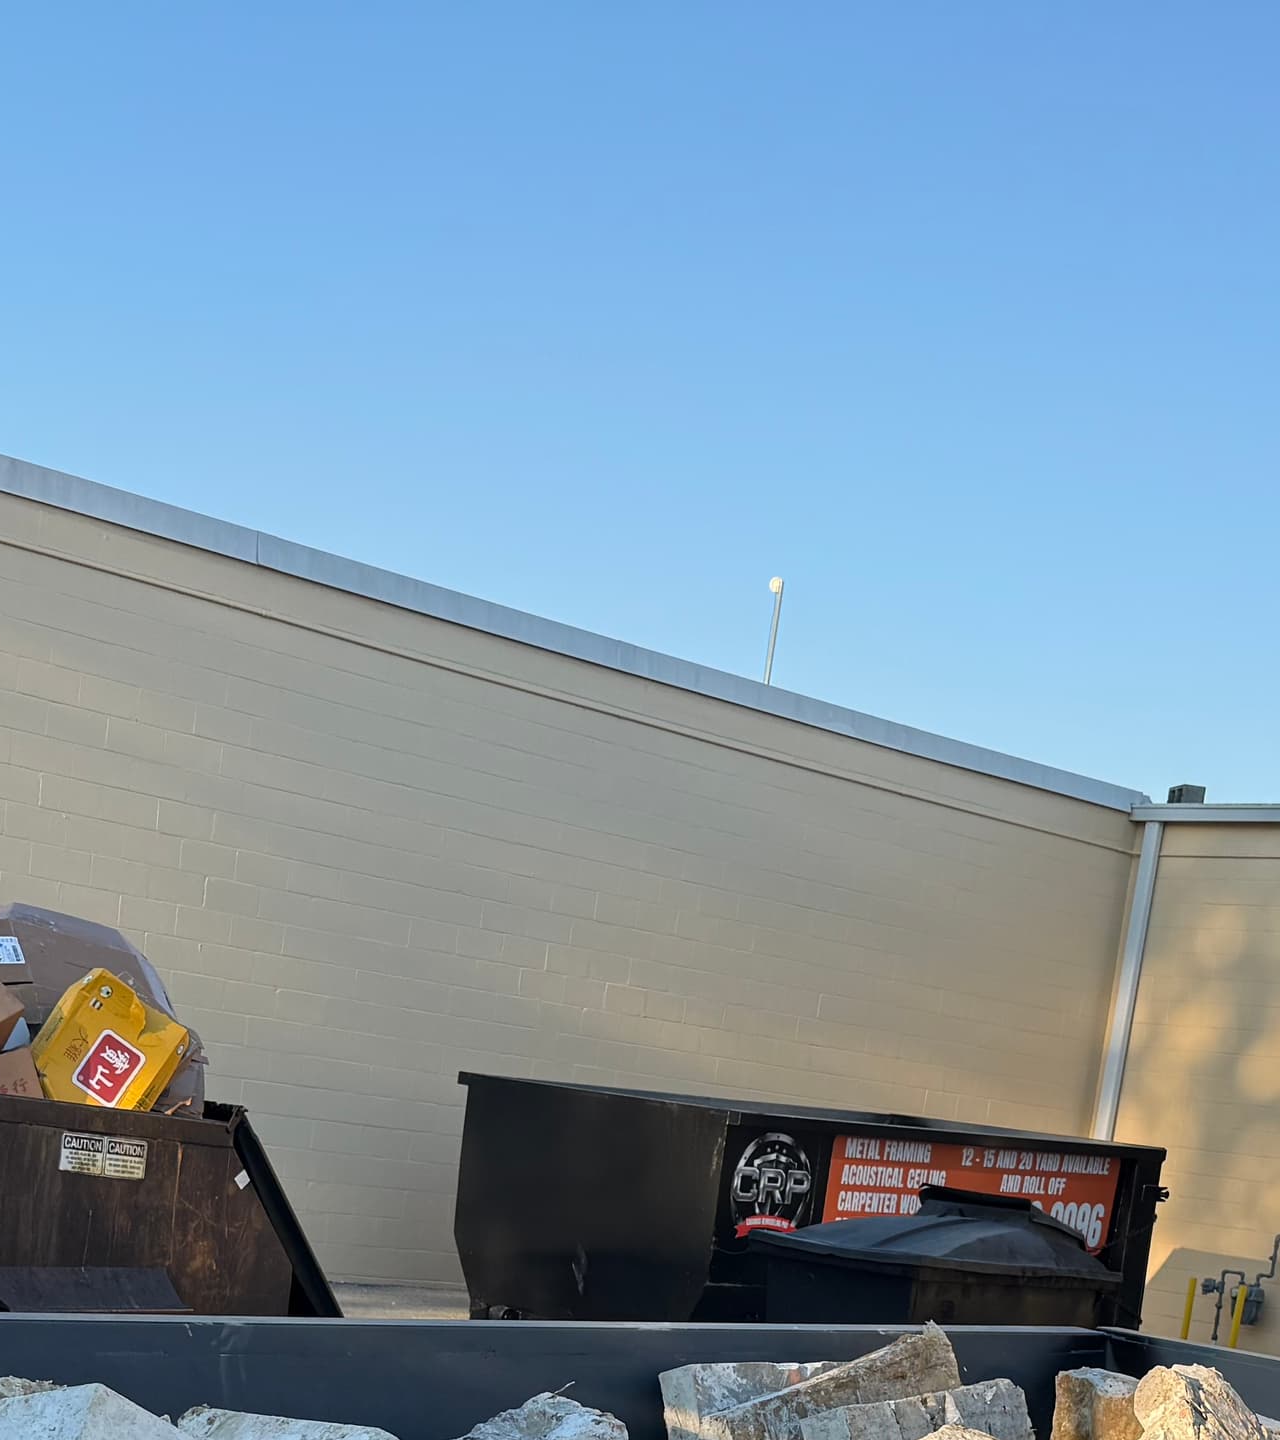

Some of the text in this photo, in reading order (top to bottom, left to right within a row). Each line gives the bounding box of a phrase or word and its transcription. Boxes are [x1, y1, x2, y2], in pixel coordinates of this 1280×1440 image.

[64, 1136, 103, 1151] CAUTION
[108, 1142, 144, 1157] CAUTION
[845, 1137, 932, 1164] METAL FRAMING
[961, 1147, 974, 1166] 12
[983, 1149, 995, 1168] 15
[996, 1150, 1018, 1170] AND
[1019, 1151, 1034, 1171] 20
[1035, 1152, 1061, 1172] YARD
[1061, 1154, 1111, 1175] AVAILABLE
[733, 1167, 811, 1205] CRP
[841, 1164, 947, 1189] ACOUSTICAL CEILING
[1000, 1174, 1067, 1196] AND ROLL OFF
[837, 1190, 898, 1214] CARPENTER
